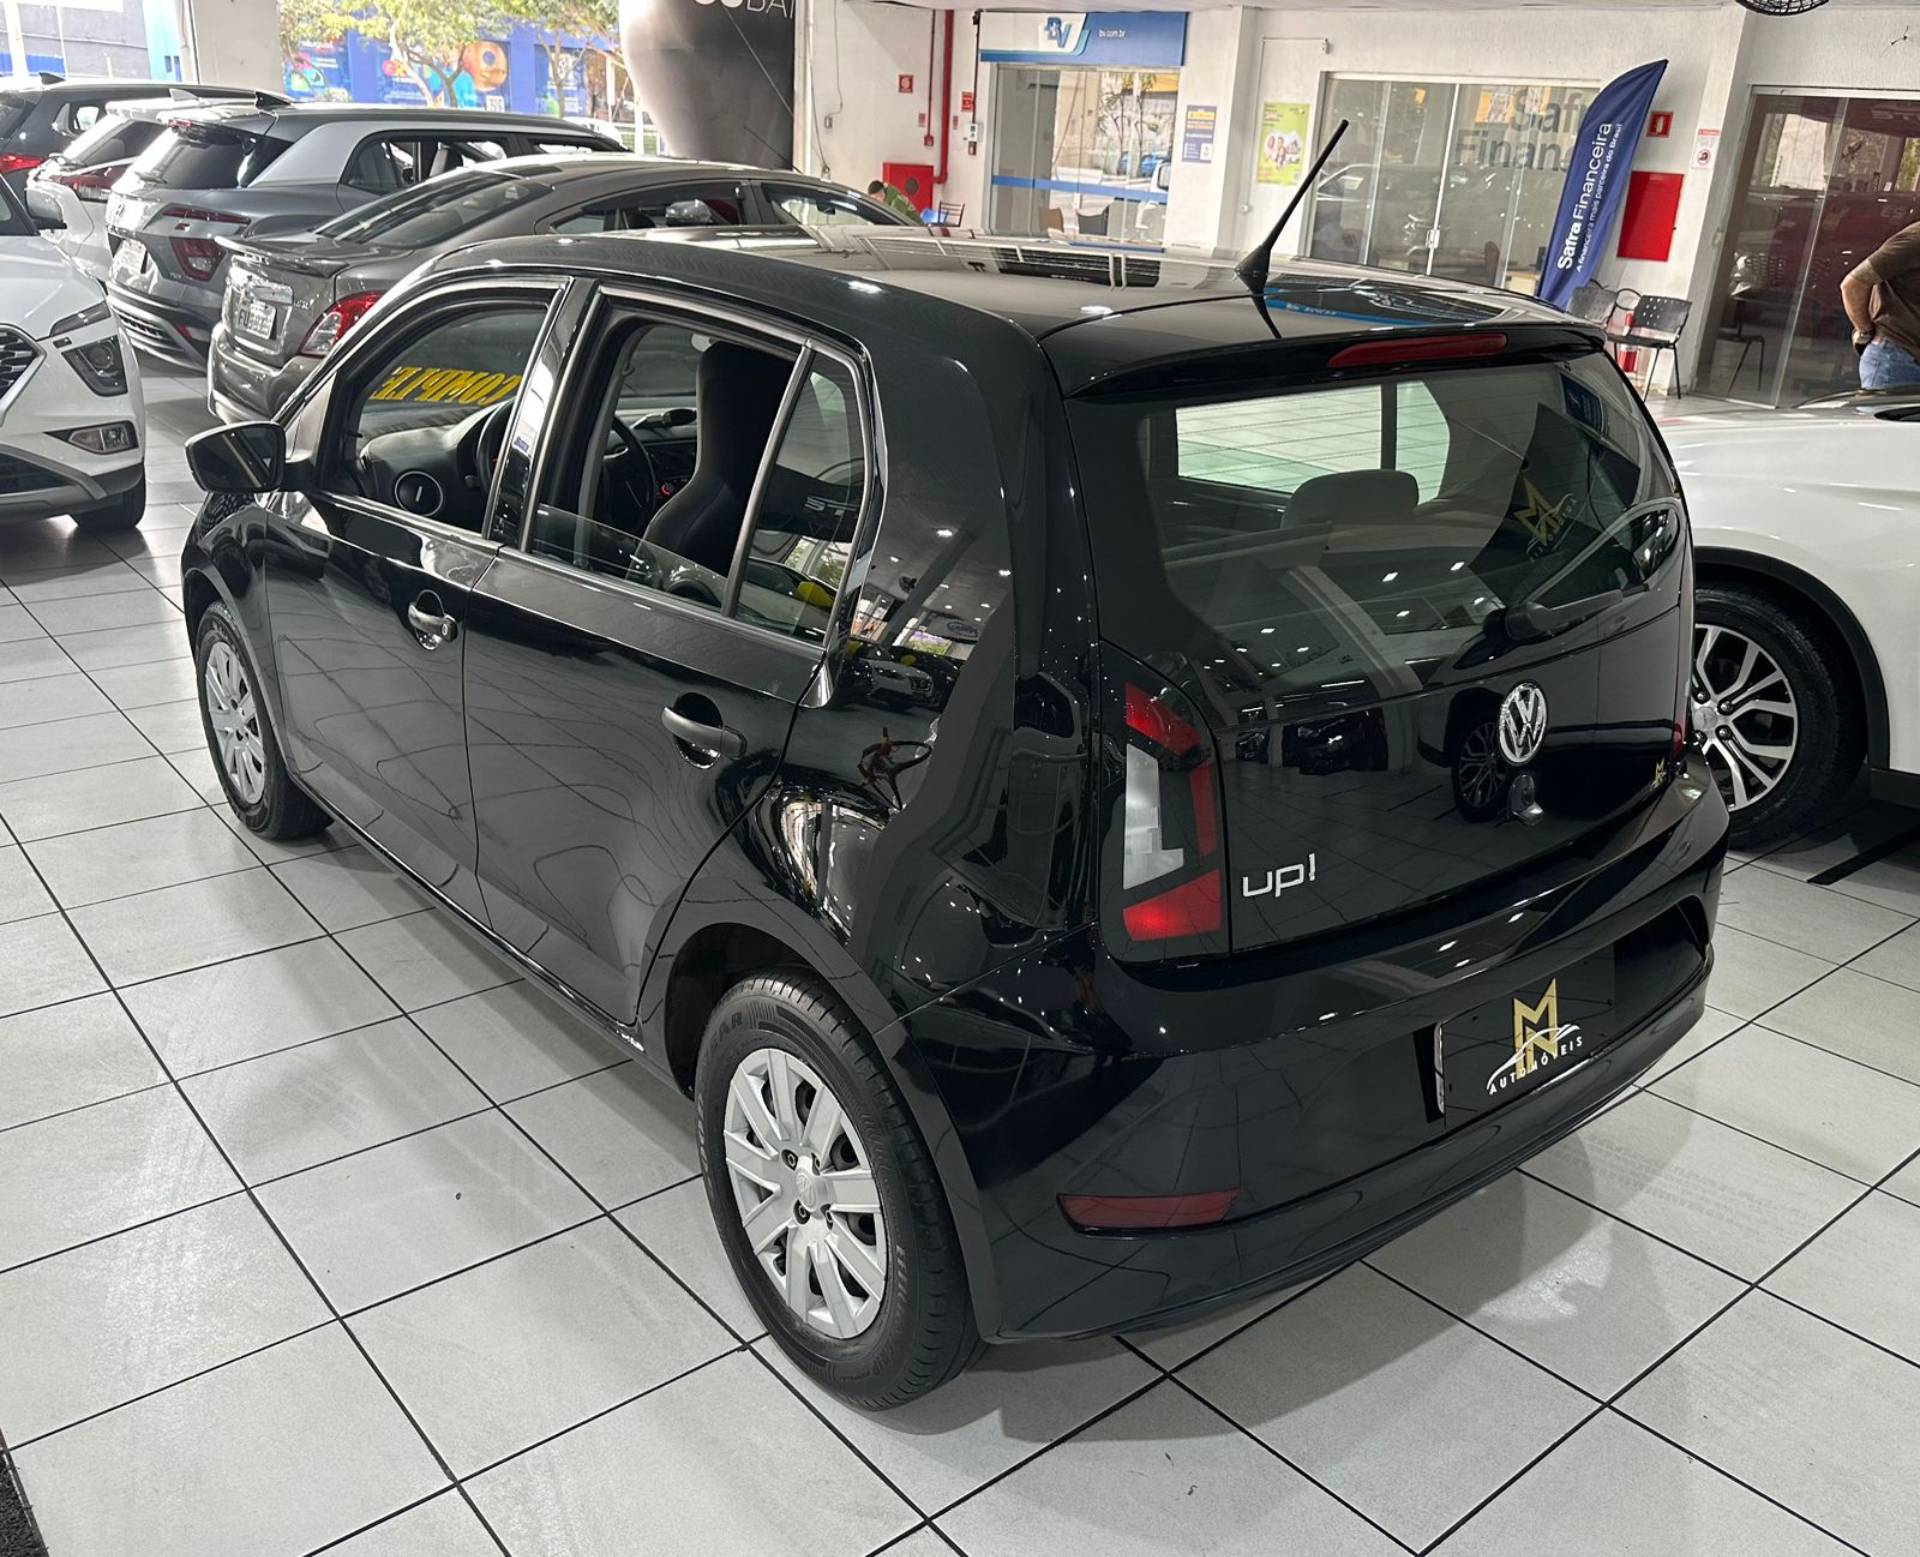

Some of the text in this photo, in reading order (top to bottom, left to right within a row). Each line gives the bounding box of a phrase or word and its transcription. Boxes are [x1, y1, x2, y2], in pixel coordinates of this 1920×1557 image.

[1609, 124, 1623, 149] Brasil
[1605, 149, 1614, 163] do
[1557, 123, 1612, 270] Safra Financeira
[1595, 164, 1609, 200] parceira
[1589, 199, 1600, 222] mais
[1243, 853, 1316, 897] up!
